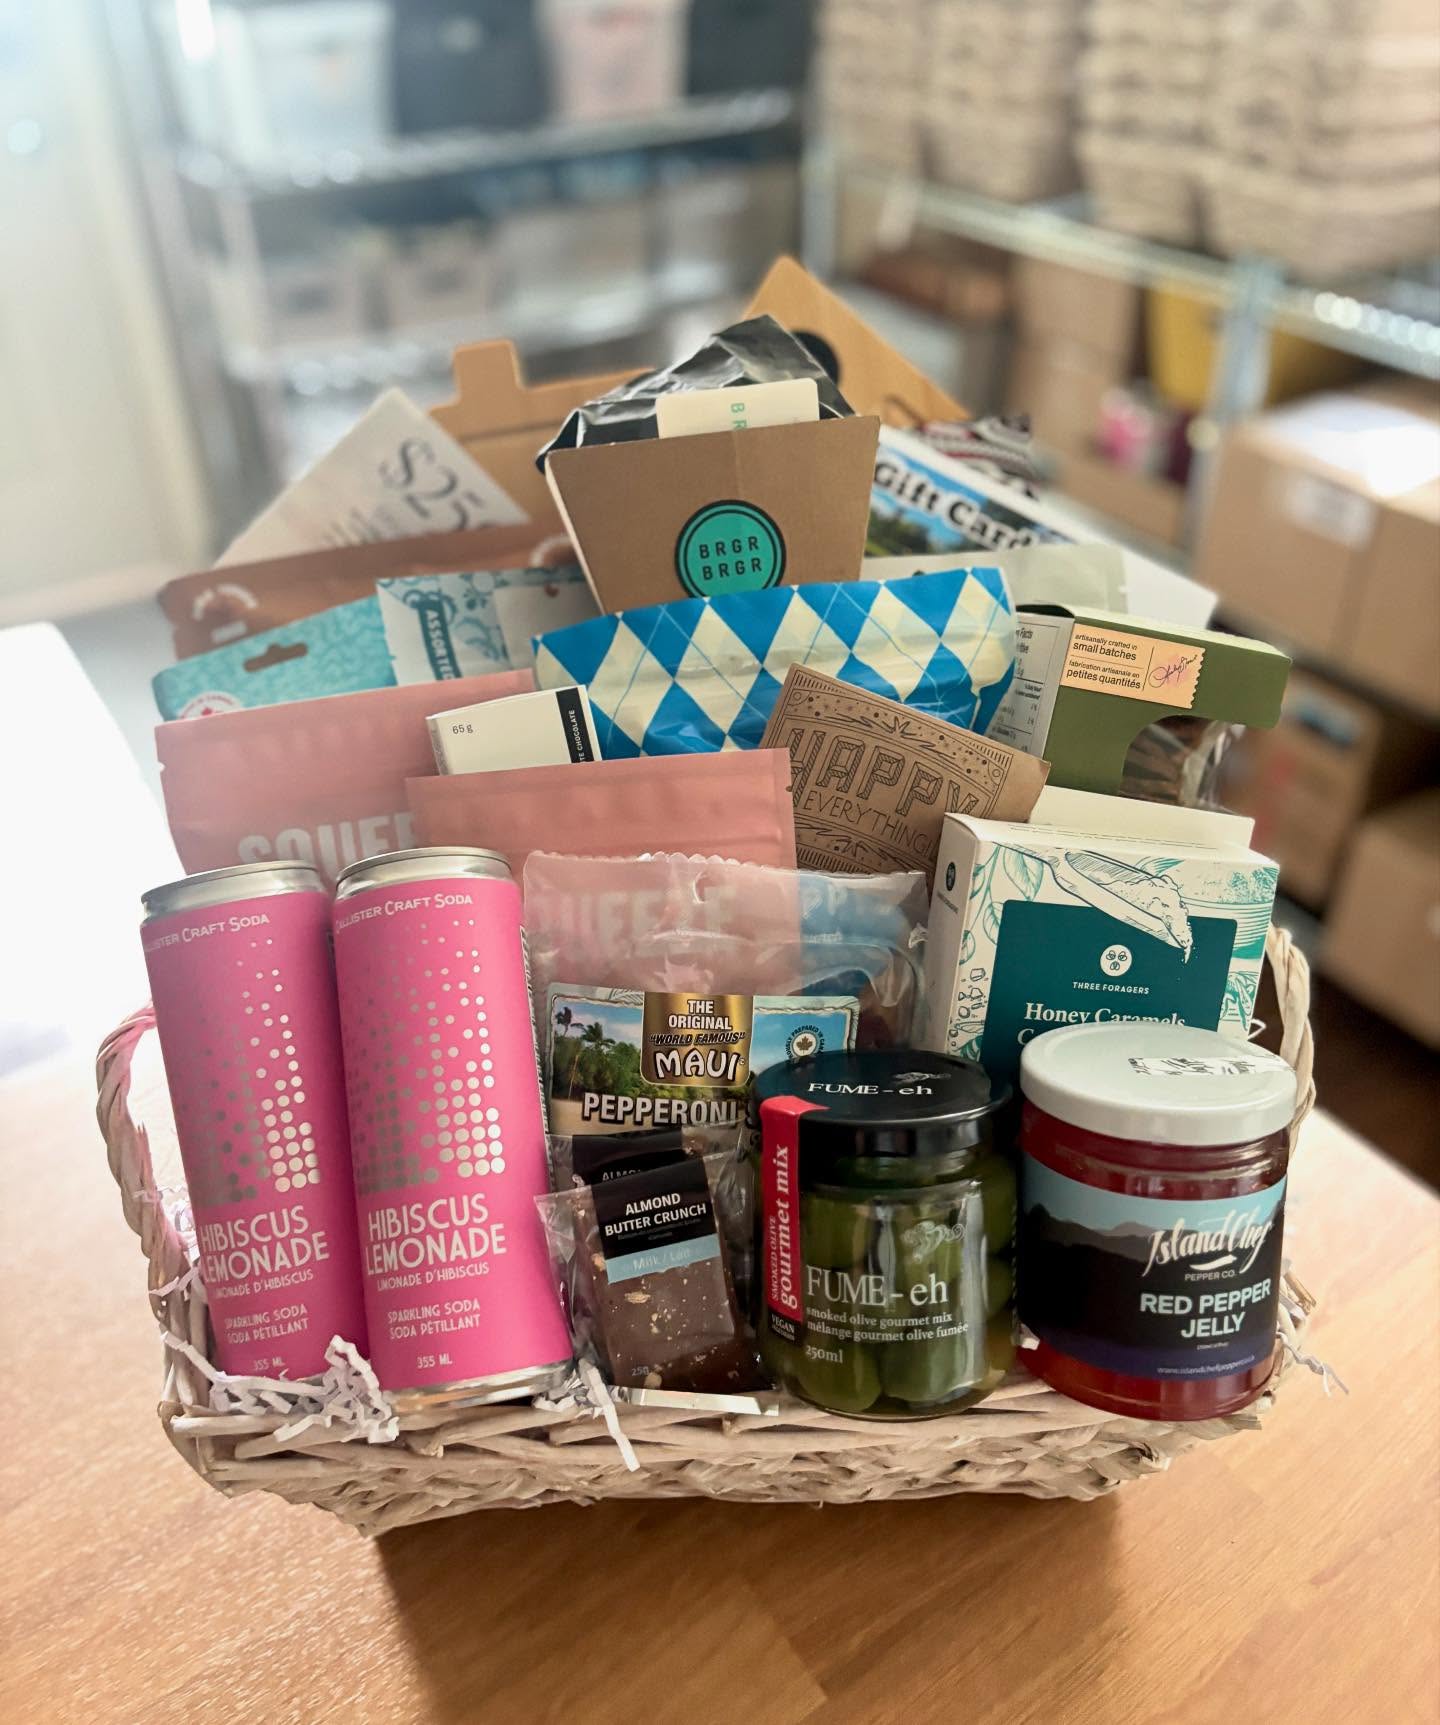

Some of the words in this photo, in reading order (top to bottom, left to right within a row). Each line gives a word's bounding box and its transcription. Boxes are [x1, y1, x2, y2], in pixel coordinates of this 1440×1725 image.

[874, 463, 939, 511] Gift
[699, 536, 760, 559] BRGR
[702, 558, 763, 581] BRGR
[1073, 642, 1099, 654] small
[1099, 646, 1137, 661] batches
[1075, 634, 1107, 646] artisanally
[1108, 640, 1131, 650] crafted
[1066, 669, 1098, 682] petites
[1098, 674, 1141, 690] quantités
[1069, 660, 1101, 672] fabrication
[1102, 667, 1131, 678] artisanale
[452, 725, 465, 735] 65
[466, 723, 474, 734] g
[569, 709, 584, 752] CHOCOLATE
[789, 728, 980, 818] HAPPY
[384, 897, 432, 916] CRAFT
[433, 893, 473, 909] SODA
[182, 922, 226, 943] CRAFT
[229, 914, 270, 932] SODA
[1072, 981, 1101, 991] THREE
[1102, 984, 1150, 995] FORAGERS
[687, 1000, 714, 1014] THE
[1024, 1002, 1091, 1024] Honey
[668, 1014, 732, 1030] ORIGINAL
[653, 1047, 740, 1082] MAUI
[582, 1091, 738, 1127] PEPPERONI
[774, 1144, 789, 1194] mix
[625, 1193, 681, 1216] ALMOND
[200, 1205, 309, 1253] HIBISCUS
[368, 1193, 489, 1242] HIBISCUS
[604, 1216, 651, 1237] BUTTER
[654, 1203, 707, 1225] CRUNCH
[768, 1215, 776, 1250] OLIVE
[202, 1231, 330, 1283] LEMONADE
[365, 1223, 507, 1276] LEMONADE
[777, 1199, 797, 1310] gourmet
[254, 1269, 314, 1294] D'HIBISCUS
[377, 1273, 422, 1291] LIMONADE
[426, 1262, 489, 1284] D'HIBISCUS
[769, 1252, 778, 1301] SMOKED
[1185, 1272, 1221, 1282] PEPPER
[1140, 1293, 1193, 1315] RED
[1199, 1278, 1272, 1314] PEPPER
[224, 1312, 271, 1330] SPARKLING
[274, 1303, 308, 1321] SODA
[388, 1304, 441, 1323] SPARKLING
[444, 1298, 481, 1316] SODA
[806, 1305, 847, 1323] smoked
[850, 1313, 877, 1327] olive
[880, 1315, 929, 1329] gourmet
[932, 1312, 953, 1324] mix
[390, 1325, 417, 1340] SODA
[771, 1313, 795, 1333] VEGAN
[807, 1319, 851, 1340] mélange
[853, 1328, 904, 1342] gourmet
[906, 1327, 934, 1341] olive
[936, 1321, 969, 1338] fumée
[1181, 1311, 1246, 1338] JELLY
[227, 1331, 250, 1345] SODA
[417, 1355, 435, 1368] 355
[439, 1353, 453, 1366] ML
[805, 1344, 843, 1364] 250ml
